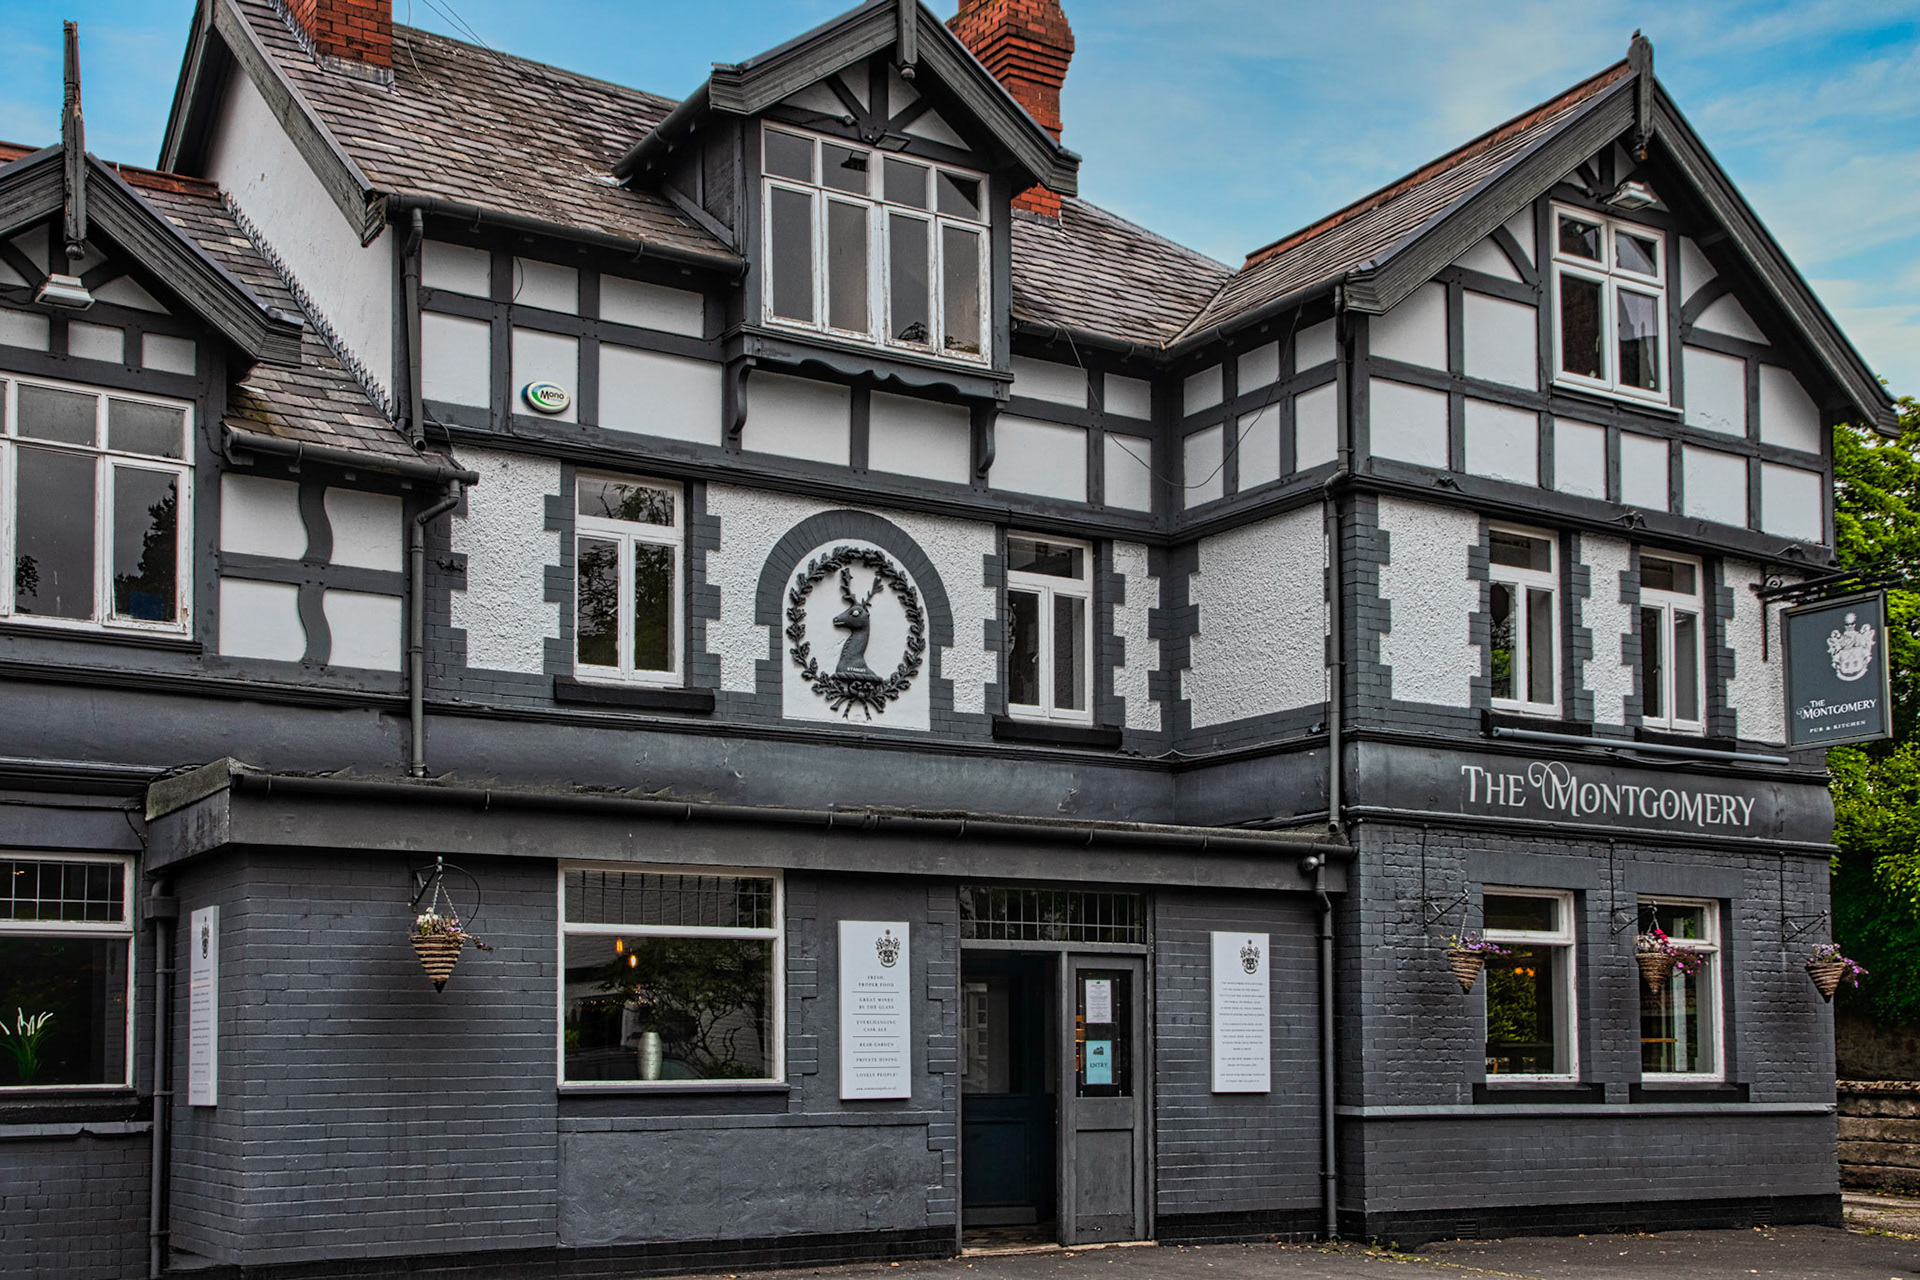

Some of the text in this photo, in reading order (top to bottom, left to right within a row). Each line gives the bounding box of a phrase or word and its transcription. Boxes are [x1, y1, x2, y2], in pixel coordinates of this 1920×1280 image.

[540, 390, 565, 400] Mono
[1809, 699, 1826, 708] THE
[1796, 698, 1877, 720] MONTGOMERY
[1833, 720, 1866, 730] KITCHEN
[1461, 761, 1755, 827] THE MONTGOMERY
